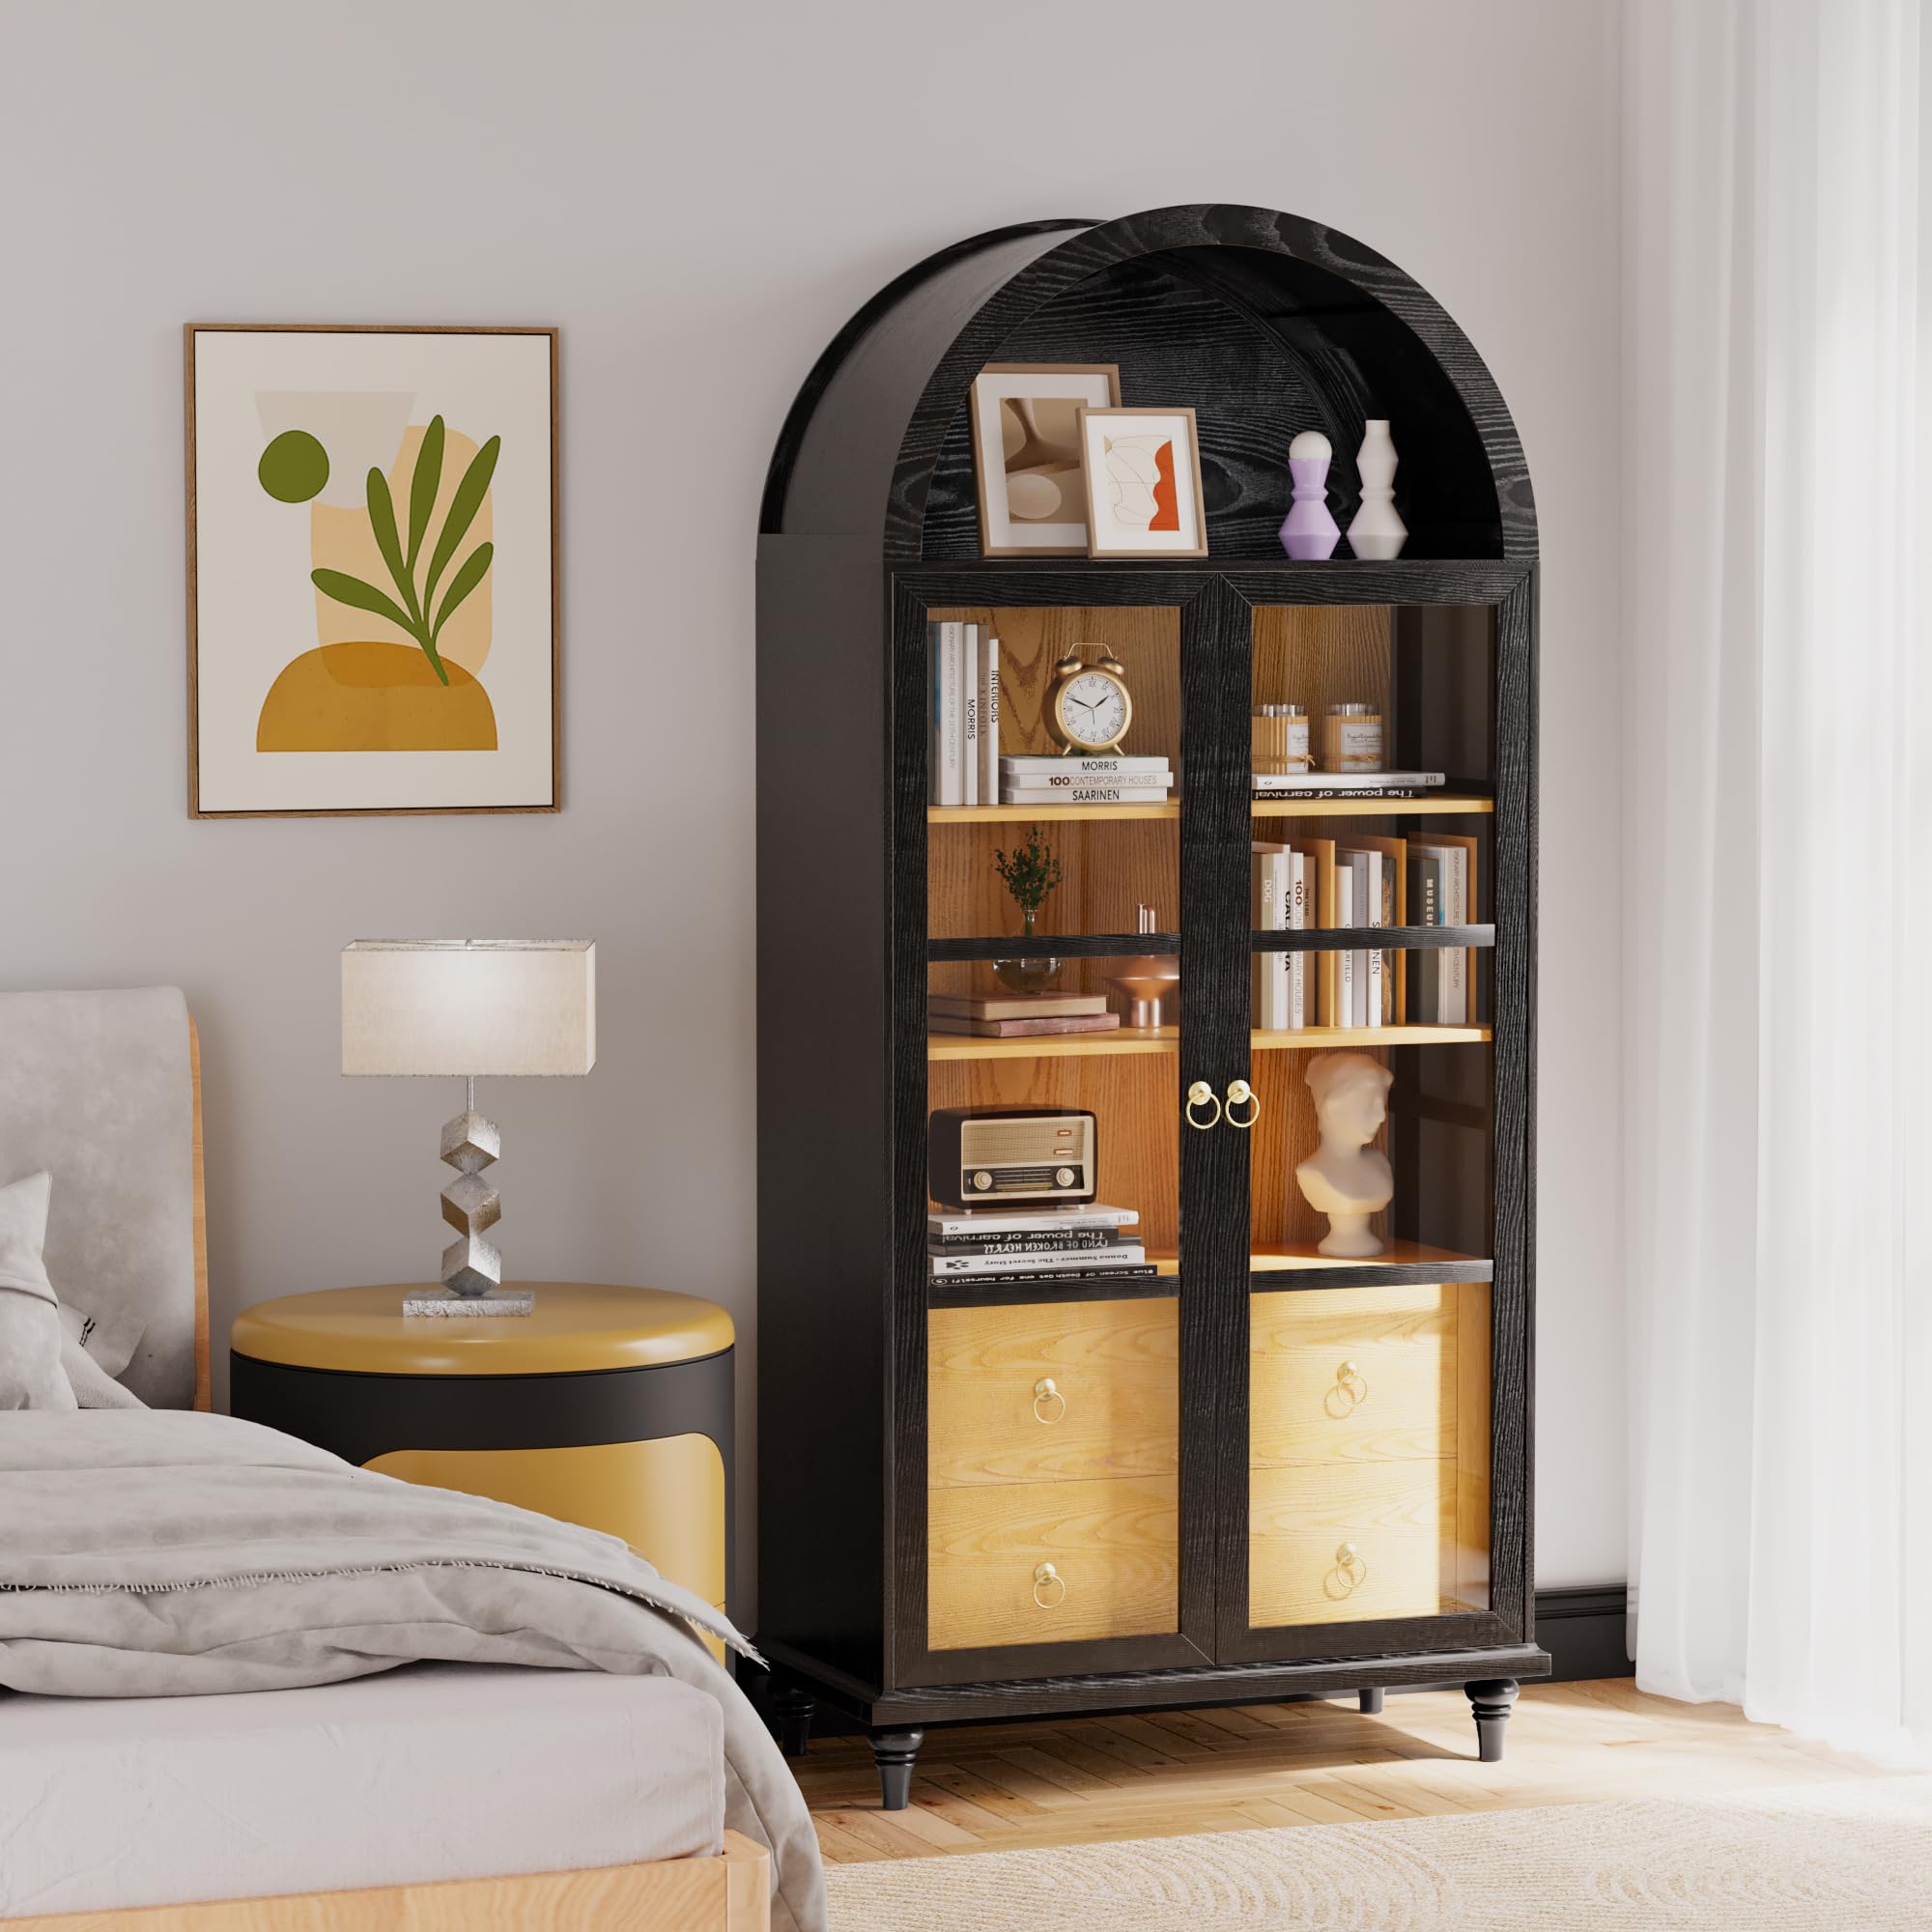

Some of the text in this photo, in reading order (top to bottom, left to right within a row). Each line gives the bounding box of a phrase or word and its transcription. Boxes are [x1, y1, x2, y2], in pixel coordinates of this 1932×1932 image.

[1082, 761, 1118, 771] MORRIS
[1128, 776, 1157, 784] HOUSES
[1072, 790, 1120, 801] SAARINEN
[1256, 790, 1312, 799] carnival
[1315, 790, 1333, 799] of
[1004, 1233, 1022, 1241] of
[1028, 1231, 1072, 1239] power
[1077, 1231, 1105, 1239] The
